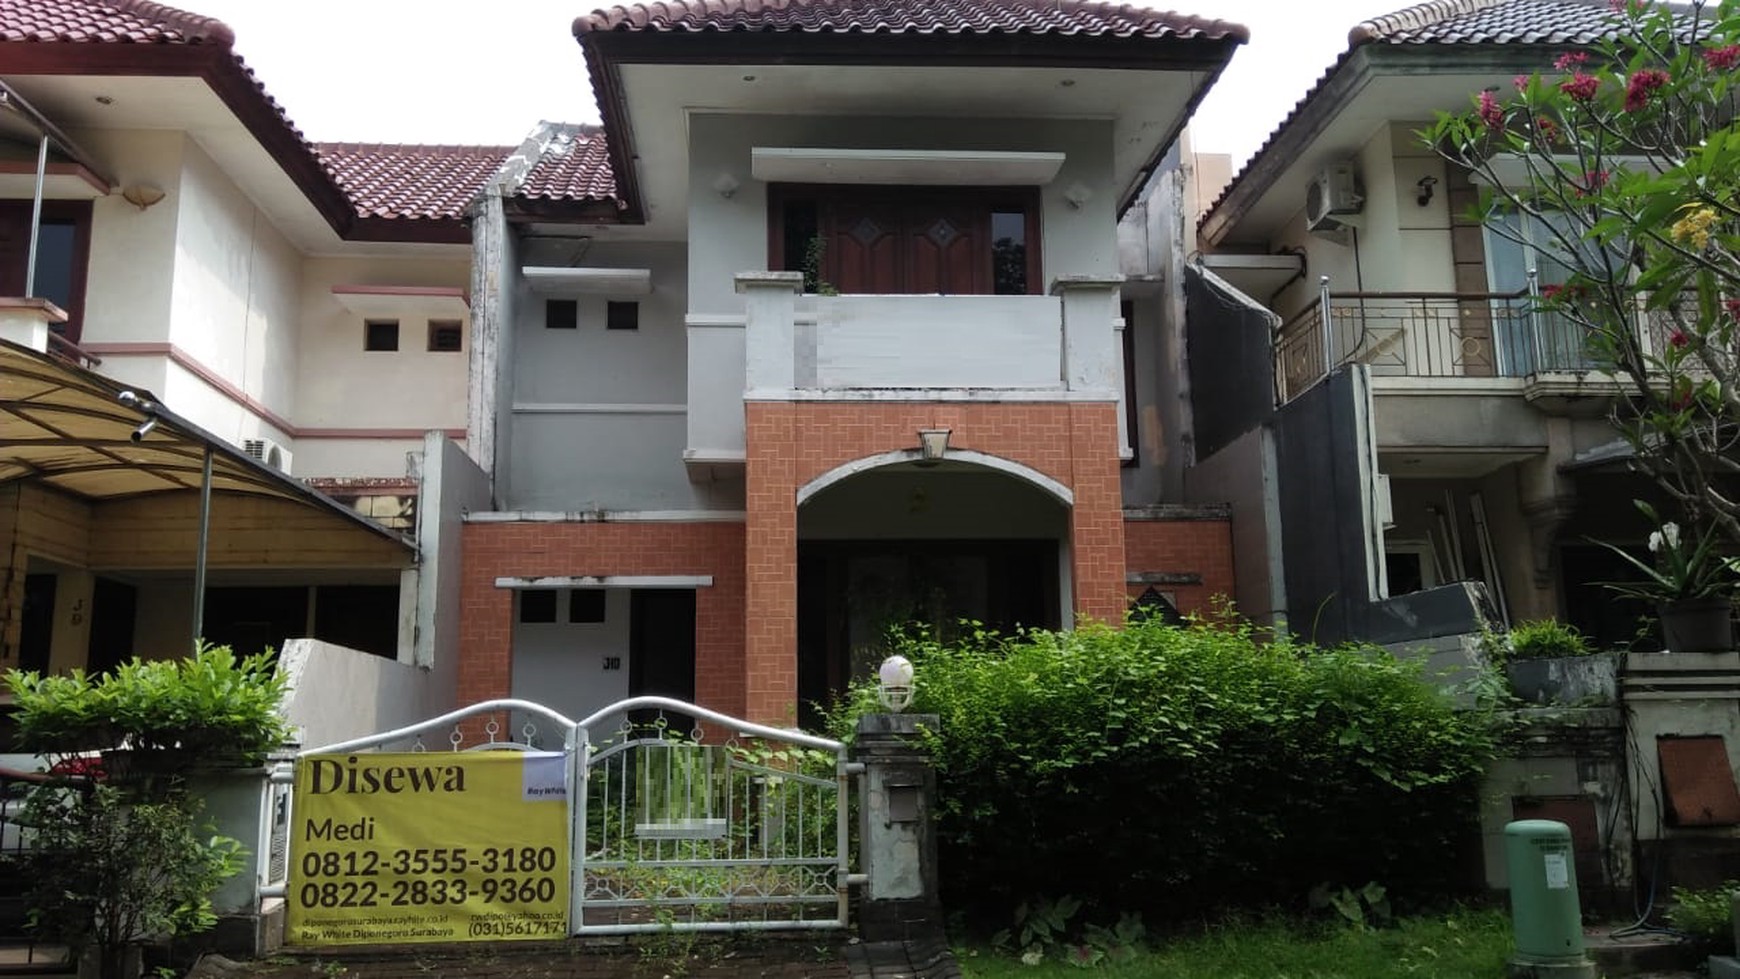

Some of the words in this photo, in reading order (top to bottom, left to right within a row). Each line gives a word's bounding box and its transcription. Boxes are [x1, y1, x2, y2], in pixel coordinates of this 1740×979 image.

[309, 757, 466, 795] Disewa
[527, 787, 544, 796] Ray
[304, 817, 375, 842] Medi
[302, 847, 556, 877] 0812-3555-3180
[300, 877, 556, 908] 0822-2833-9360
[302, 931, 319, 941] Ray
[322, 929, 351, 939] White
[352, 928, 409, 939] Diponegoro
[410, 927, 454, 937] Surabaya
[468, 921, 567, 938] (031)5617171
